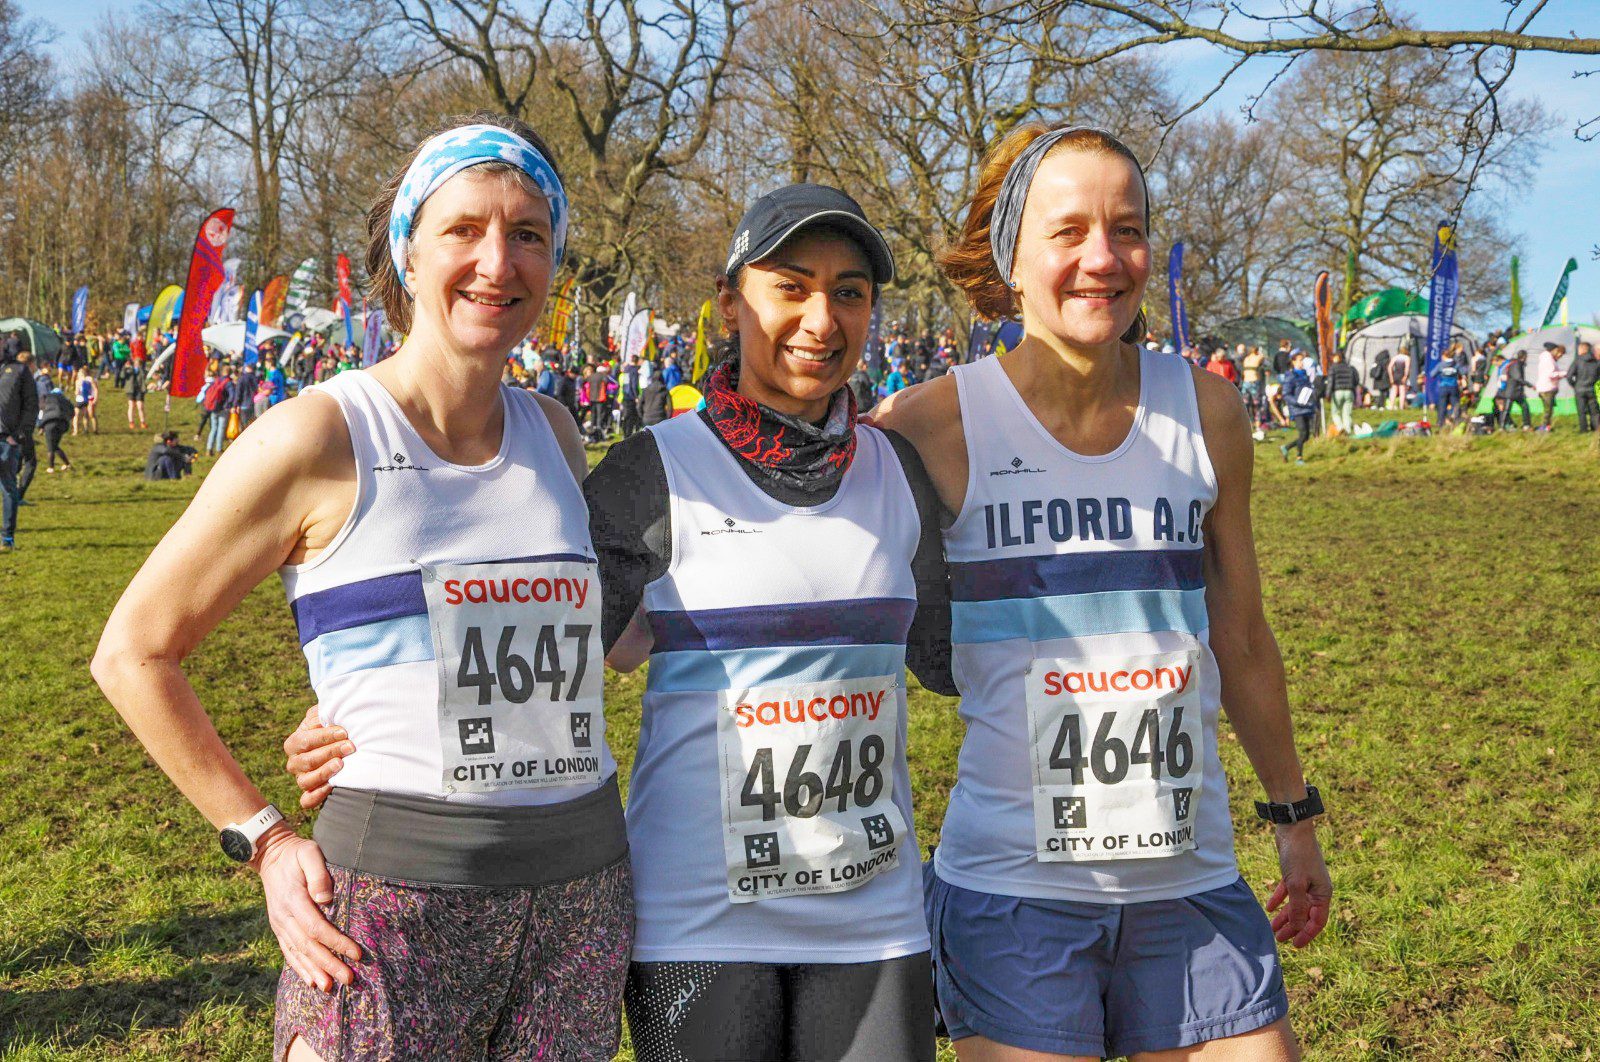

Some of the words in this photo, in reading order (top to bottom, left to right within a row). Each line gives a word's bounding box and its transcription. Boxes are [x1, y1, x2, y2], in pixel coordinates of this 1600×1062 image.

[1430, 275, 1446, 361] CAMBRIDGE
[373, 465, 429, 473] RONHILL
[990, 467, 1047, 477] RONHILL
[701, 528, 763, 537] RONHILL
[984, 497, 1134, 550] ILFORD
[445, 577, 588, 609] saucony
[457, 625, 593, 706] 4647
[1044, 665, 1193, 697] saucony
[735, 690, 885, 728] saucony
[1049, 706, 1193, 785] 4646
[453, 762, 505, 782] CITY
[512, 759, 538, 777] OF
[545, 756, 599, 775] LONDON
[741, 735, 885, 822] 4648
[1046, 836, 1095, 852] CITY
[1103, 834, 1129, 850] OF
[1137, 825, 1193, 848] LONDON
[737, 873, 787, 892] CITY
[795, 869, 823, 885] OF
[831, 847, 896, 882] LONDON
[666, 979, 695, 1024] 2XU
